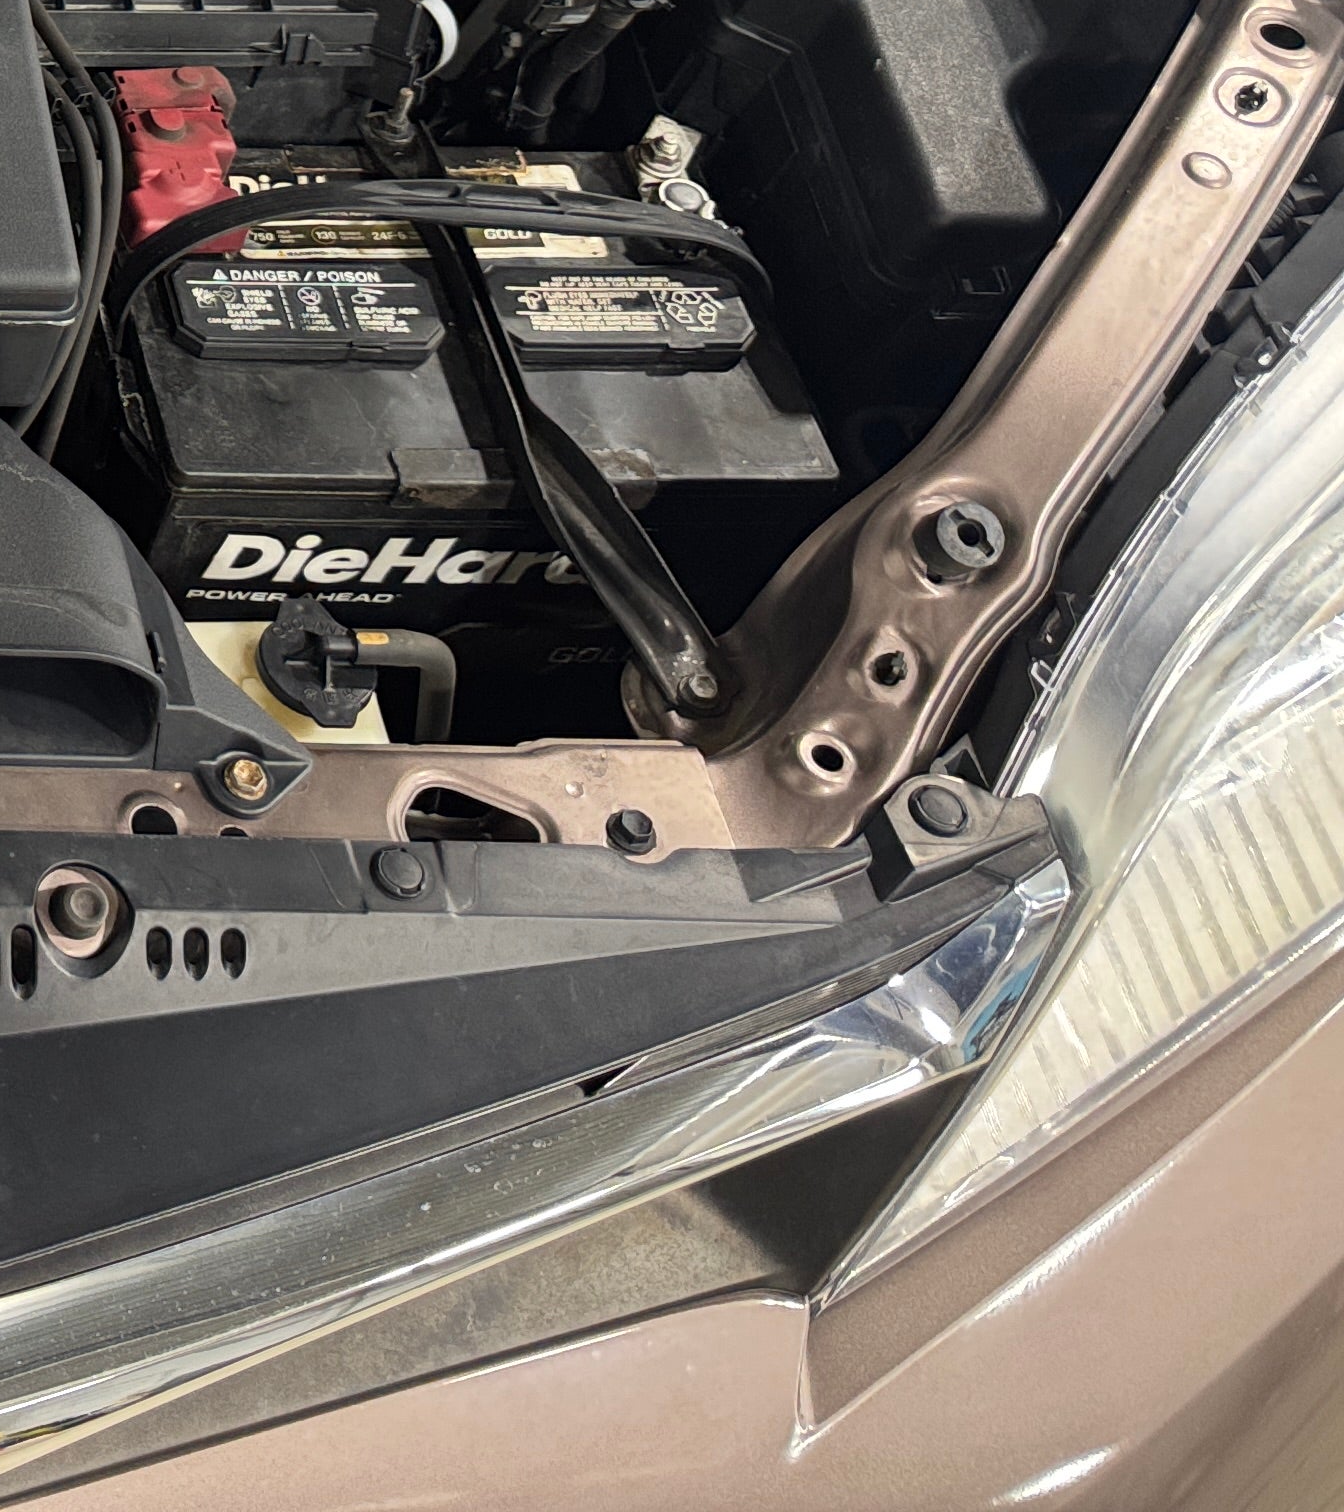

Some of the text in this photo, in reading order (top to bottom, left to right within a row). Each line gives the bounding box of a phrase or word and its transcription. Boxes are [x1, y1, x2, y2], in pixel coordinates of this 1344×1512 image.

[316, 231, 338, 241] 130
[229, 269, 300, 282] DANGER
[317, 271, 382, 283] POISON
[186, 589, 395, 604] POWER HEAD
